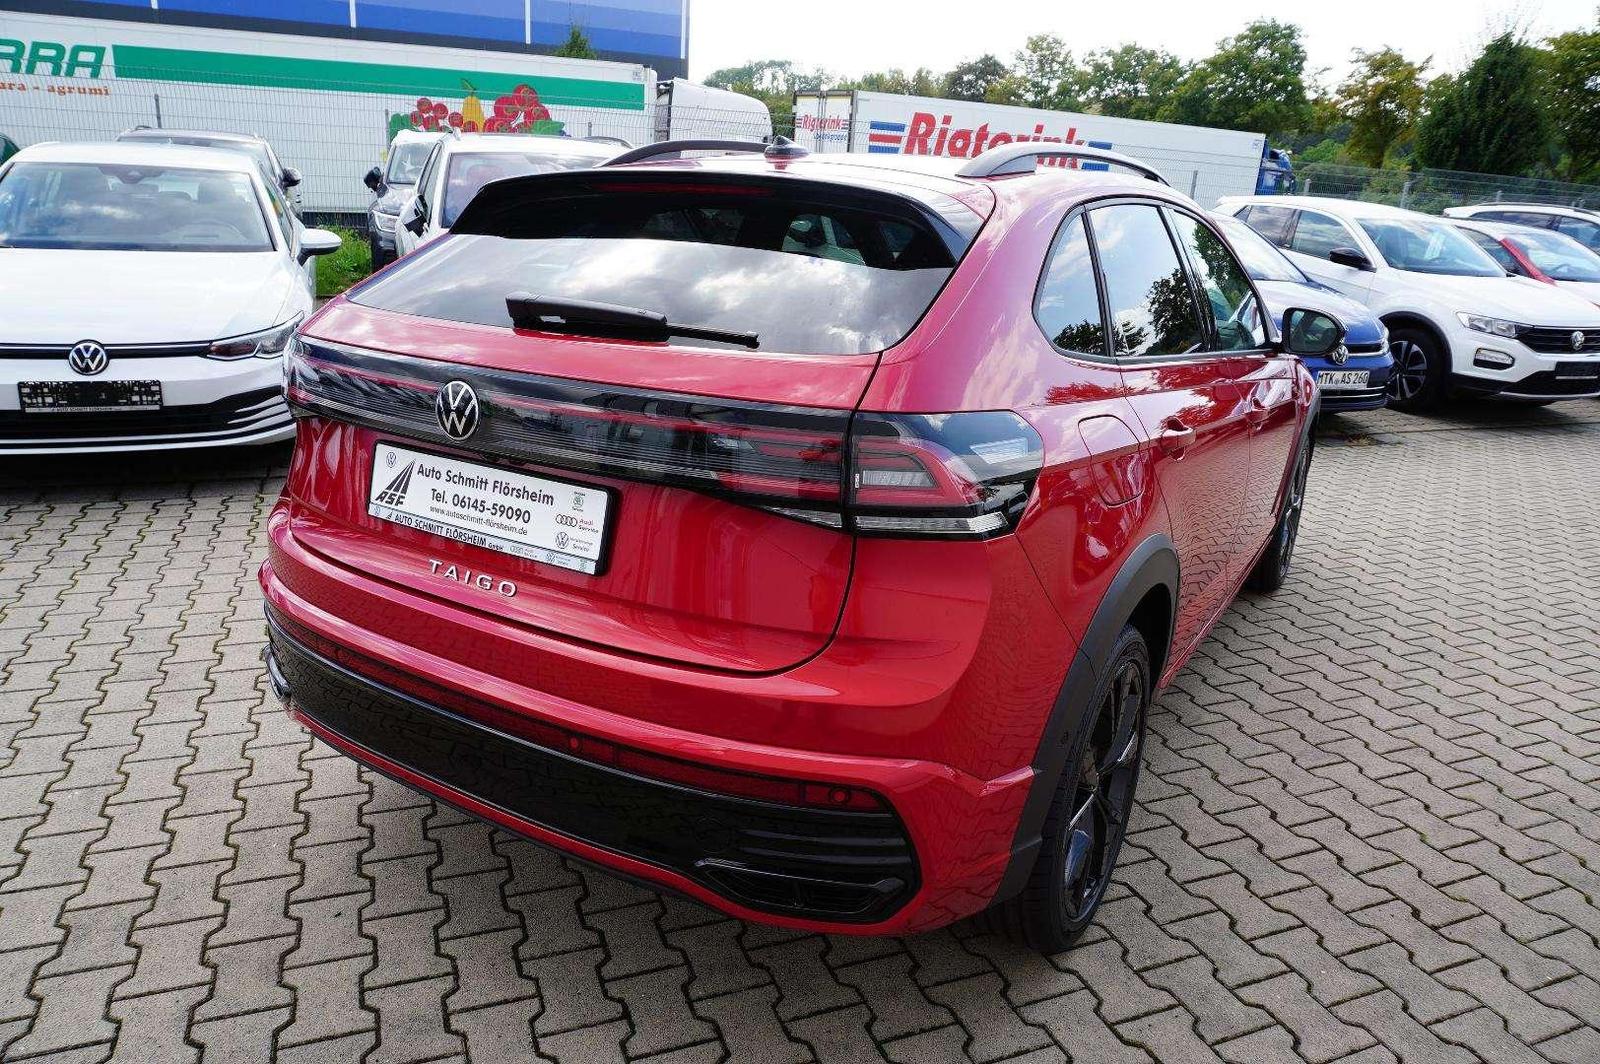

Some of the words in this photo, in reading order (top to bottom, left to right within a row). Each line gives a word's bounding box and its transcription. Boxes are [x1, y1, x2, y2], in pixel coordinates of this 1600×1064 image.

[47, 85, 110, 96] agrumi
[1318, 372, 1335, 385] MTK
[1340, 373, 1352, 385] AS
[375, 490, 406, 507] ASF
[417, 464, 442, 481] Auto
[445, 469, 489, 492] Schmitt
[492, 480, 555, 506] Flörsheim
[431, 488, 448, 504] Tel.
[452, 493, 531, 524] 06145-59090
[394, 513, 413, 527] AUTO
[414, 519, 443, 535] SCHMITT
[445, 526, 487, 548] FLÖRSHEIM
[429, 559, 518, 599] TAIGO
